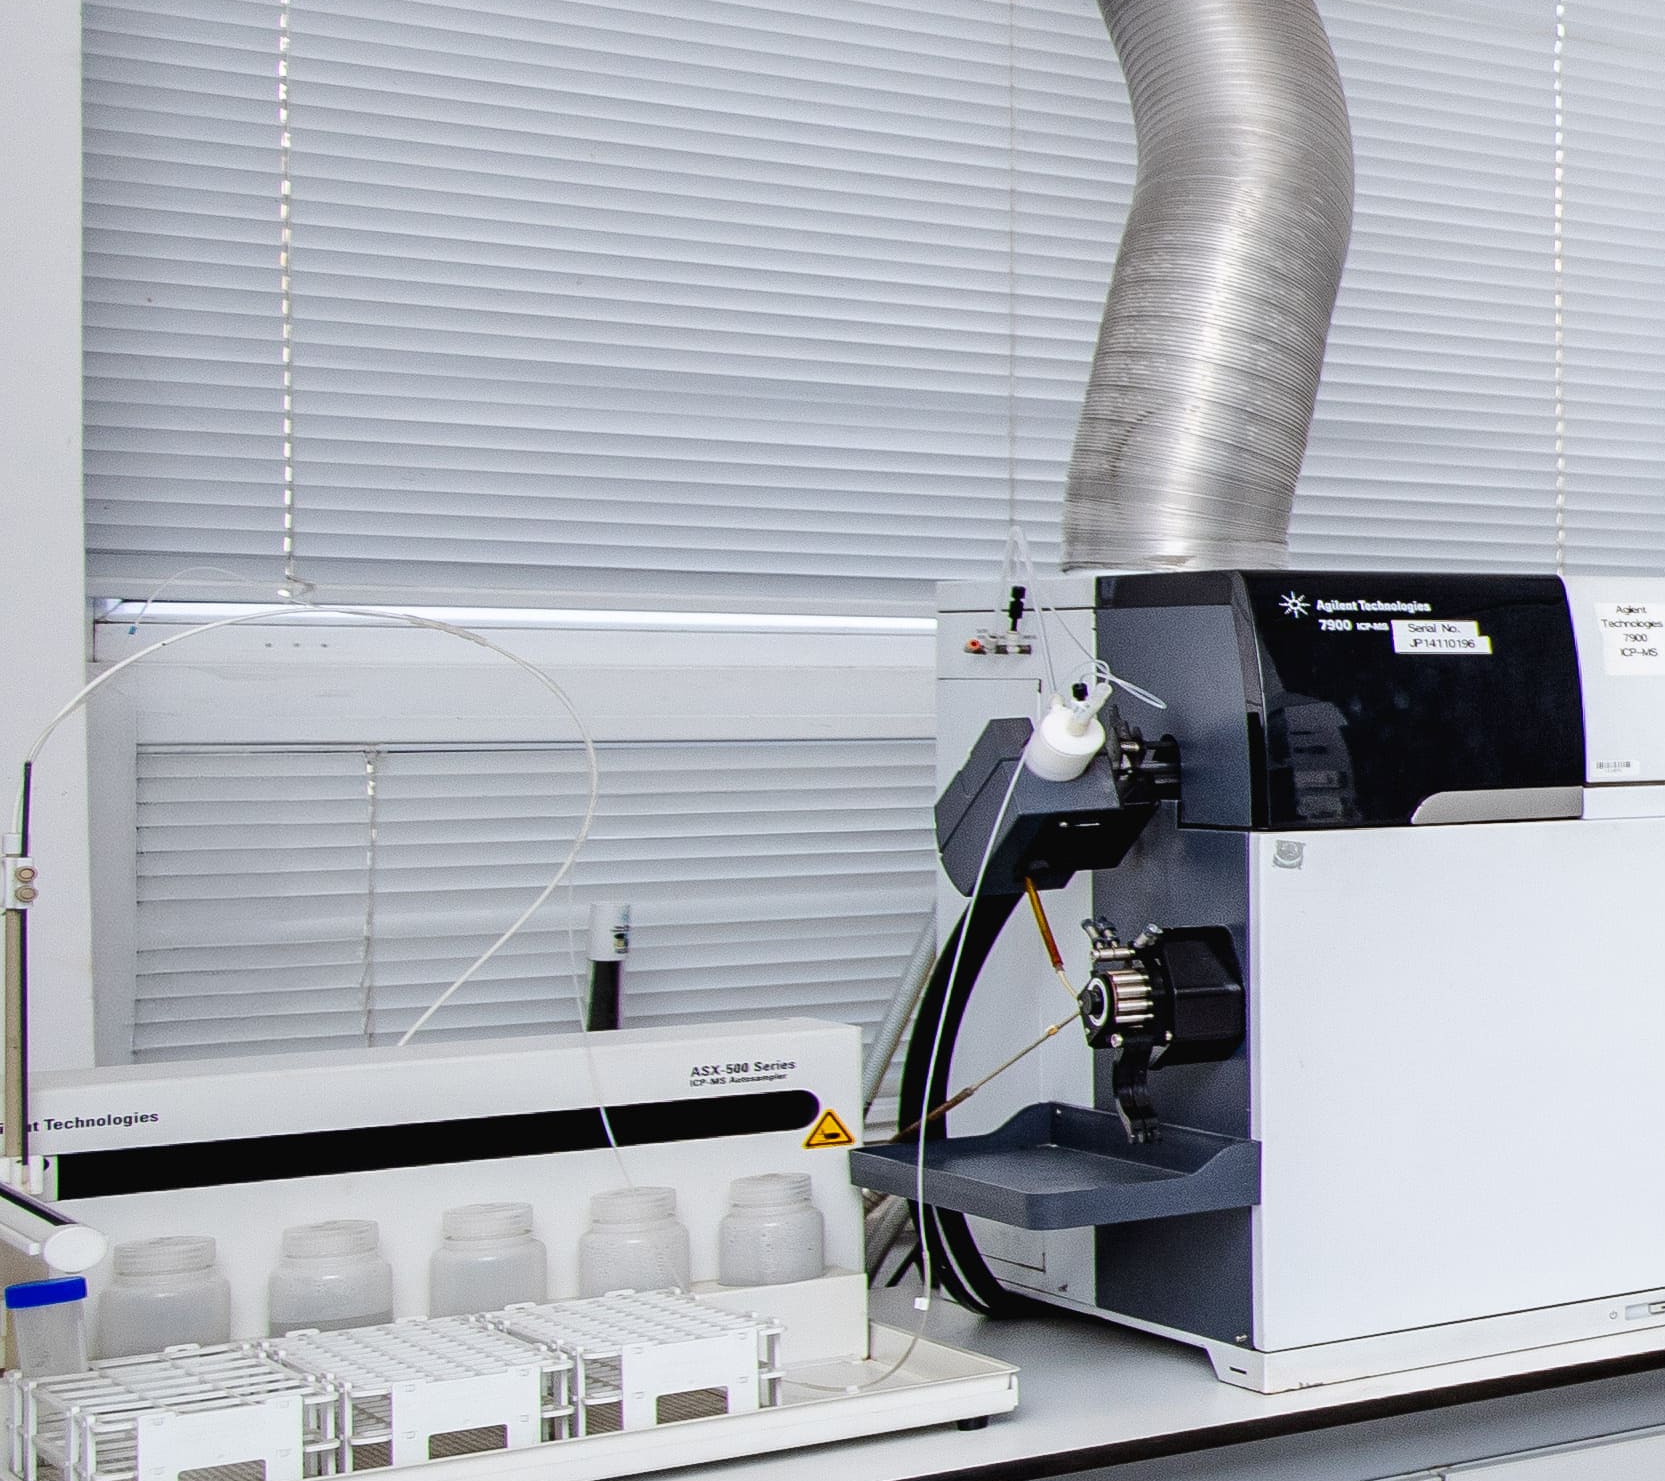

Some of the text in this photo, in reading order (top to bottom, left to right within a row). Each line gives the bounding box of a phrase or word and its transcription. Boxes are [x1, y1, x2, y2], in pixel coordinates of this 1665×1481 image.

[1316, 599, 1432, 613] Agilent Technologies
[1318, 619, 1353, 631] 7900
[1408, 623, 1462, 634] Serial No.
[1409, 638, 1476, 649] JP14110196
[1623, 633, 1648, 642] 7900
[690, 1060, 796, 1077] ASX-500 Series
[690, 1076, 726, 1088] ICP-MS
[44, 1112, 160, 1132] Technologies
